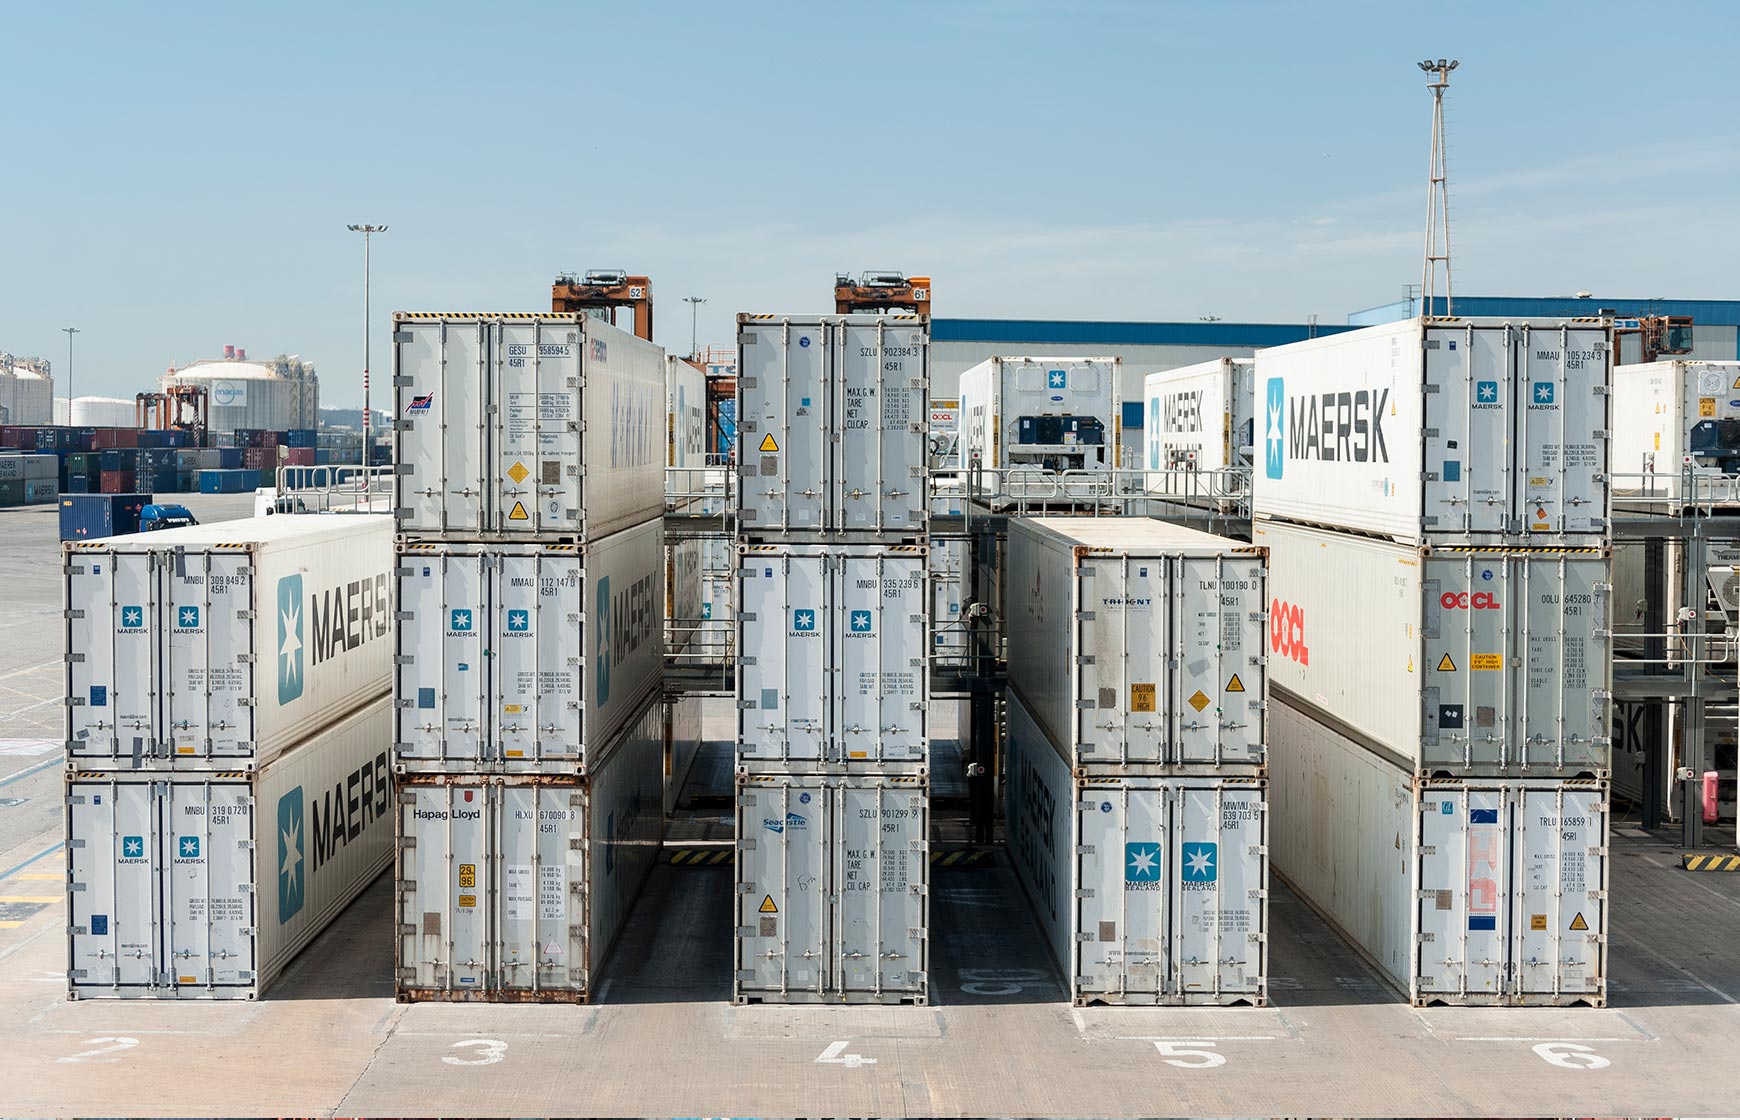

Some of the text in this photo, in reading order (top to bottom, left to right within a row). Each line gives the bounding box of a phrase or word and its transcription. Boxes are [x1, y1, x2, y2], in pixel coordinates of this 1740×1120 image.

[630, 288, 640, 297] 52
[914, 290, 924, 299] 61
[509, 346, 526, 355] GESU
[539, 346, 564, 355] 958594
[860, 348, 918, 356] SZLU 902384 3
[1537, 352, 1560, 360] MMAU
[1567, 352, 1579, 360] 105
[509, 359, 525, 367] 45R1
[884, 363, 902, 371] 45R1
[1566, 361, 1584, 369] 45R1
[848, 399, 862, 407] TARE
[847, 409, 858, 418] NET
[1164, 390, 1203, 432] MAERSK
[1290, 388, 1389, 463] MAERSK
[184, 576, 204, 584] MNBU
[211, 576, 224, 585] 309
[511, 578, 534, 586] MMAU
[541, 578, 553, 586] 112
[556, 578, 569, 586] 147
[857, 580, 877, 588] MNBU
[883, 580, 896, 588] 335
[899, 580, 912, 588] 239
[211, 585, 228, 594] 45R1
[1200, 581, 1257, 590] TLNU 100190 0
[540, 587, 558, 596] 45R1
[884, 590, 900, 598] 45R1
[1221, 597, 1239, 606] 45R1
[1441, 592, 1500, 609] OOCL
[1542, 595, 1600, 603] OOLU 645280 7
[1564, 607, 1582, 615] 45R1
[614, 570, 656, 668] MAERSK
[1271, 598, 1308, 666] OOCL
[1132, 684, 1155, 693] CAUTION
[185, 806, 205, 815] MNBU
[1224, 802, 1248, 810] MWMU
[515, 811, 575, 819] HLXU 670090 8
[859, 810, 877, 818] SZLU
[882, 810, 908, 818] 901299
[1223, 811, 1258, 820] 639 703 5
[212, 816, 230, 824] 45R1
[1540, 817, 1556, 826] TRLU
[540, 825, 557, 833] 45R1
[882, 824, 899, 832] 45R1
[1223, 821, 1239, 829] 45R1
[848, 860, 861, 869] TARE
[847, 871, 857, 880] NET
[56, 1037, 140, 1063] 2
[441, 1040, 508, 1066] 3
[814, 1041, 877, 1067] 4
[1154, 1041, 1227, 1068] 5
[1531, 1043, 1611, 1069] 6
